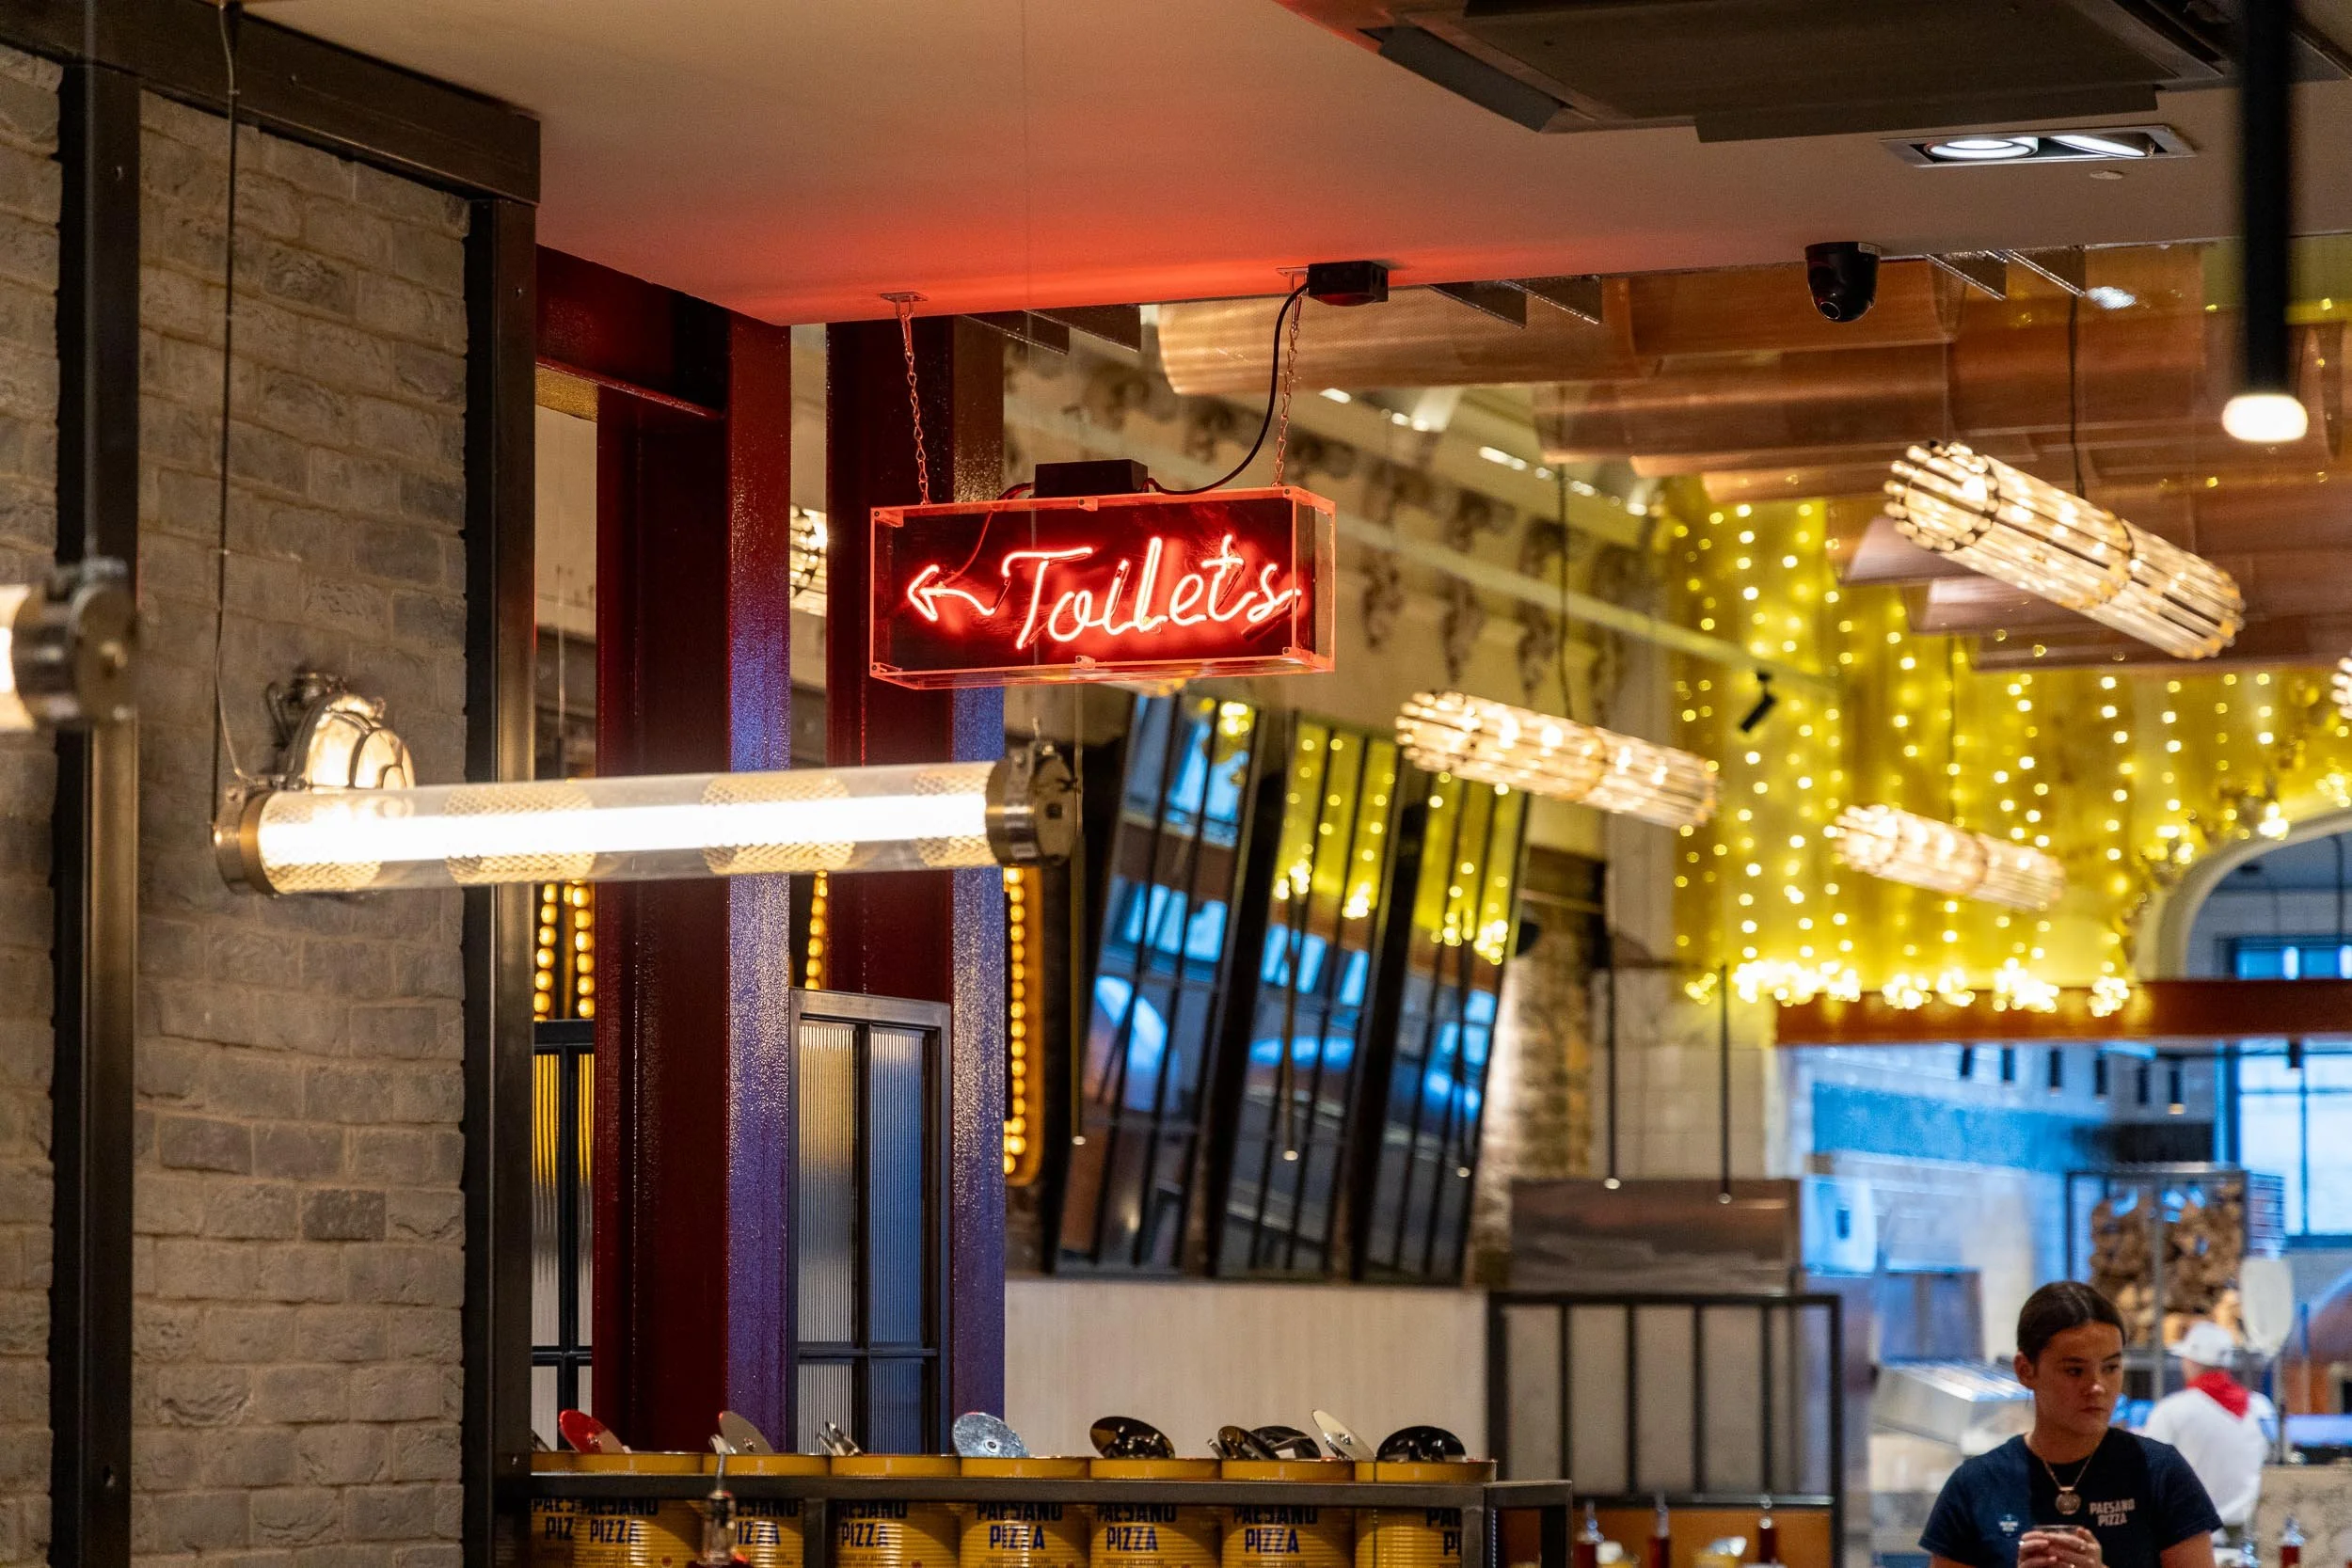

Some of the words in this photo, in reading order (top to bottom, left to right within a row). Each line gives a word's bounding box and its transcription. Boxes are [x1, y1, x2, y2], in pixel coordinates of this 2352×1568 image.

[1002, 533, 1302, 650] Toilets
[977, 1502, 1062, 1521] PAESANO
[1097, 1504, 1176, 1522] PAESANO
[1233, 1505, 1318, 1524] PAESANO
[2089, 1498, 2135, 1515] PAESANO
[546, 1517, 573, 1541] PIZ
[590, 1519, 641, 1544] PIZZA
[2097, 1513, 2128, 1527] PIZZA
[738, 1521, 780, 1545] IZZA
[842, 1523, 890, 1547] PIZZA
[990, 1525, 1044, 1549] PIZZA
[1106, 1527, 1158, 1551] PIZZA
[1245, 1528, 1299, 1554] PIZZA
